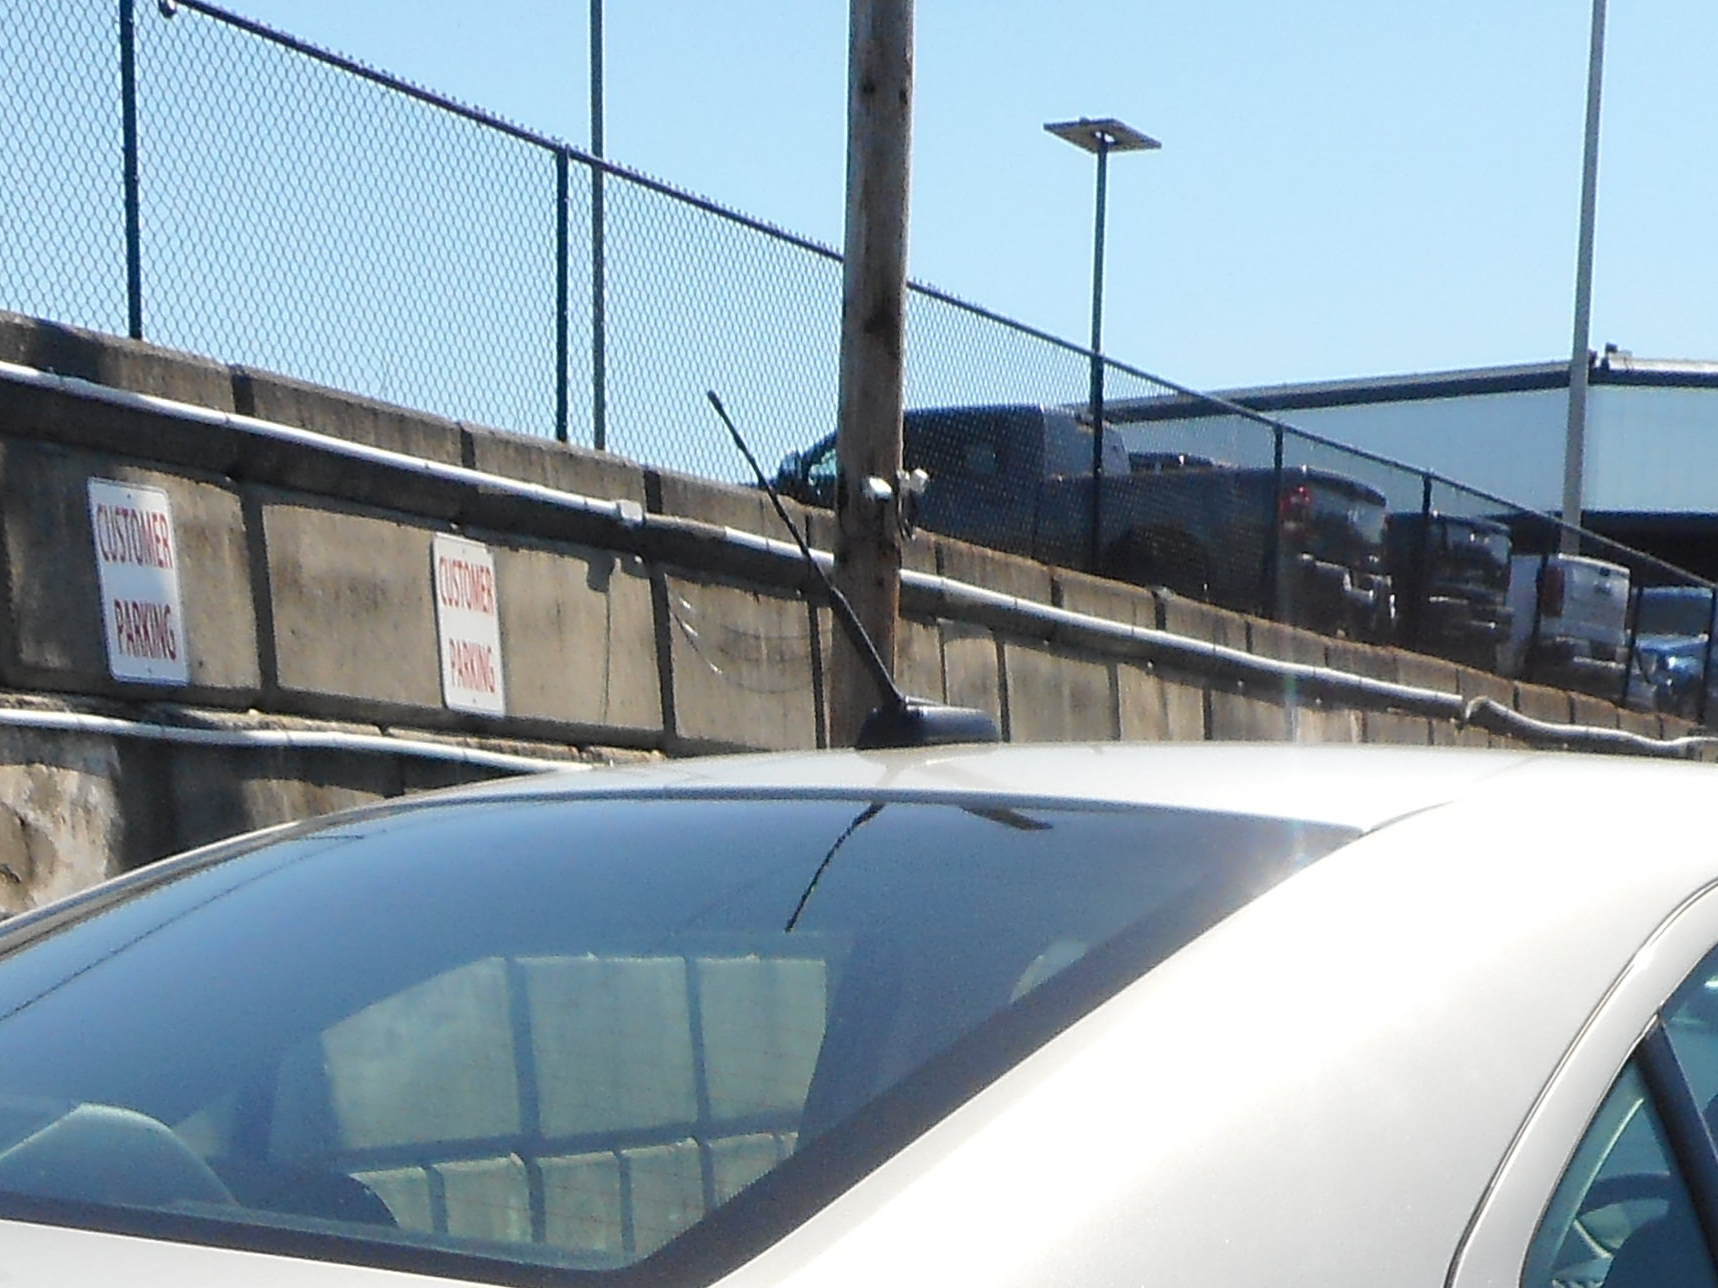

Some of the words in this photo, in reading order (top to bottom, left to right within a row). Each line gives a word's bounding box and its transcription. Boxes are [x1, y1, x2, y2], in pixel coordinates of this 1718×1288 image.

[97, 503, 173, 568] CUSTOMER
[439, 555, 495, 617] CUSTOMER
[114, 598, 177, 661] PARKING
[449, 637, 496, 694] PARKING
